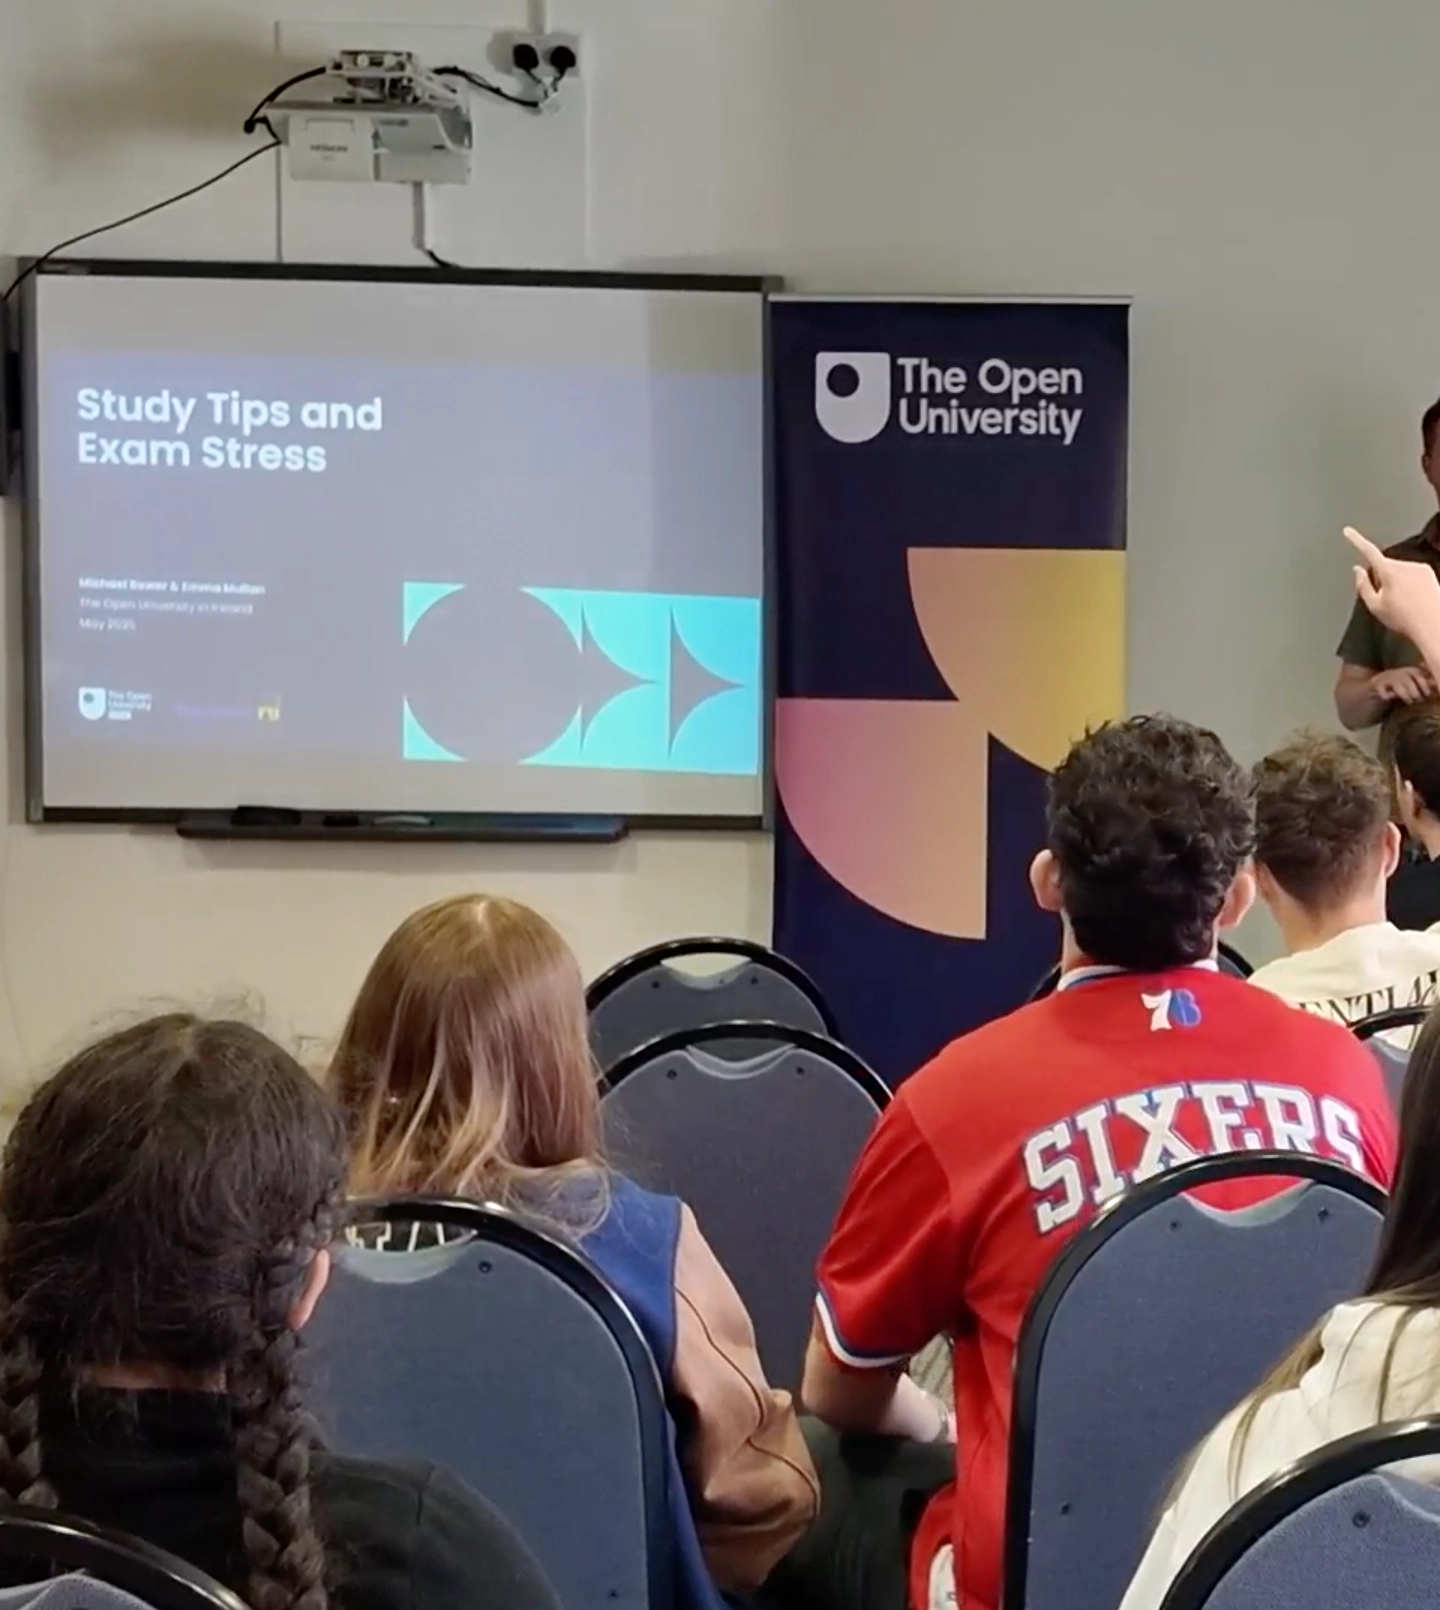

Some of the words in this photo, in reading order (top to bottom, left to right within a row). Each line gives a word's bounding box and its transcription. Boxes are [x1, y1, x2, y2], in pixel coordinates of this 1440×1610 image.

[897, 357, 967, 393] The
[978, 358, 1083, 404] Open
[76, 387, 197, 434] Study
[206, 390, 291, 437] Tips
[299, 397, 383, 431] and
[900, 398, 1083, 445] University
[78, 431, 190, 467] Exam
[201, 435, 328, 473] Stress
[103, 598, 137, 611] Open
[170, 581, 179, 593] &
[1021, 1079, 1369, 1235] SIXERS
